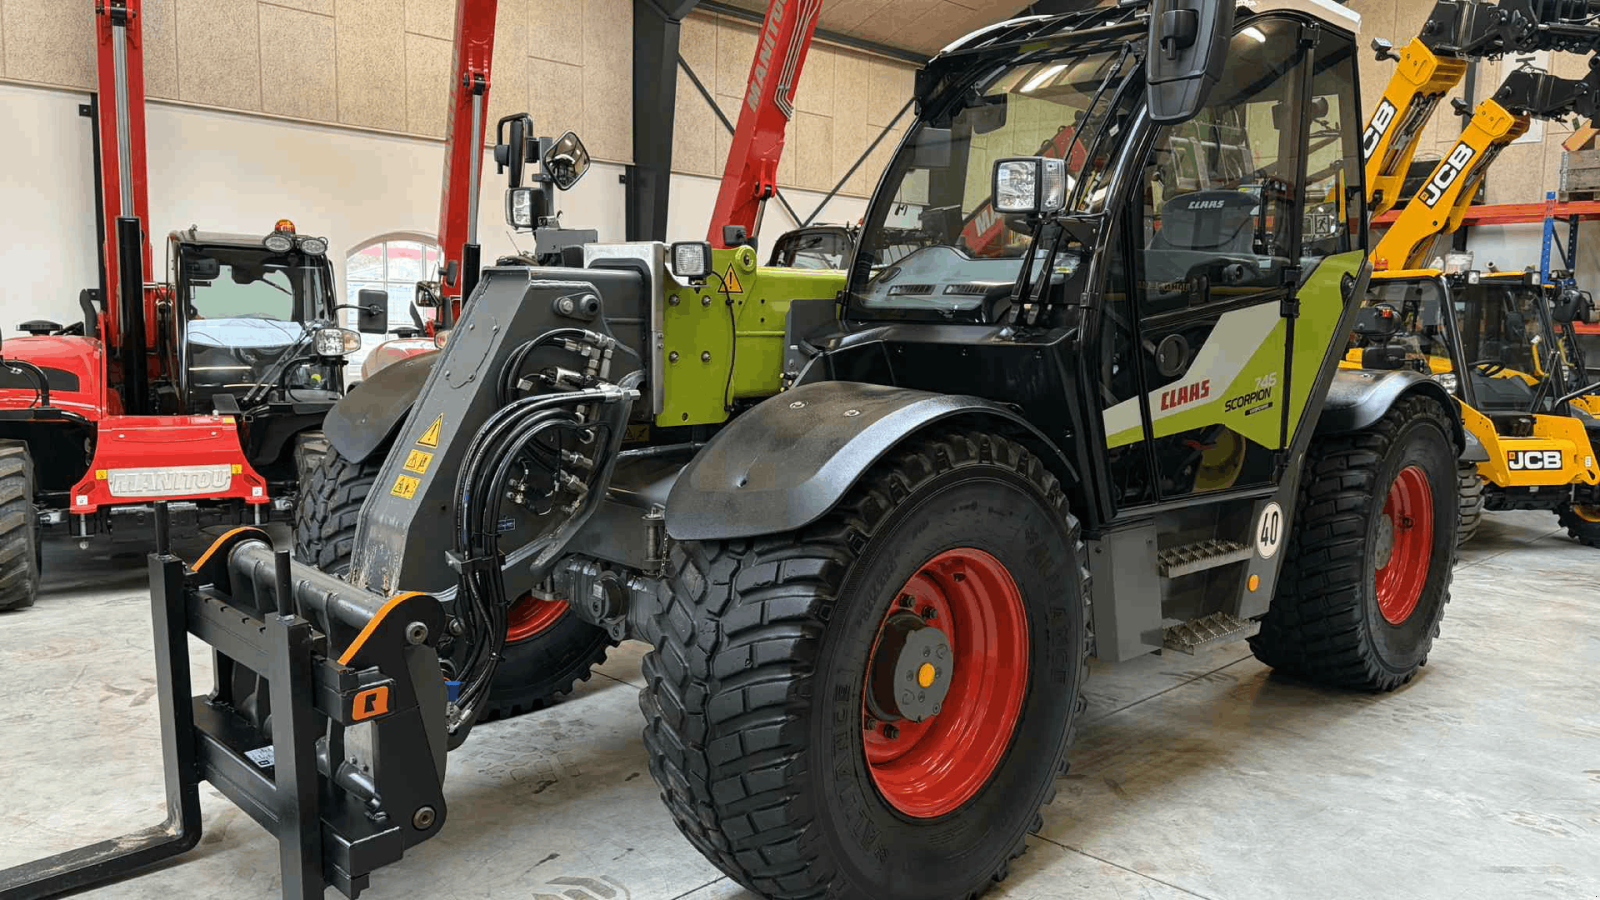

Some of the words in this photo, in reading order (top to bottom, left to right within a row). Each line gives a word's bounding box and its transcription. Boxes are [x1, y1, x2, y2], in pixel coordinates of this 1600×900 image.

[747, 0, 787, 113] MANITO
[1363, 101, 1396, 159] CB
[1425, 143, 1473, 206] JCB
[1188, 200, 1225, 209] CLAAS
[1161, 379, 1210, 411] CLAAS
[1225, 386, 1271, 412] SCORPION
[1509, 451, 1562, 469] JCB
[113, 470, 229, 493] MANITOU
[1260, 511, 1278, 546] 40
